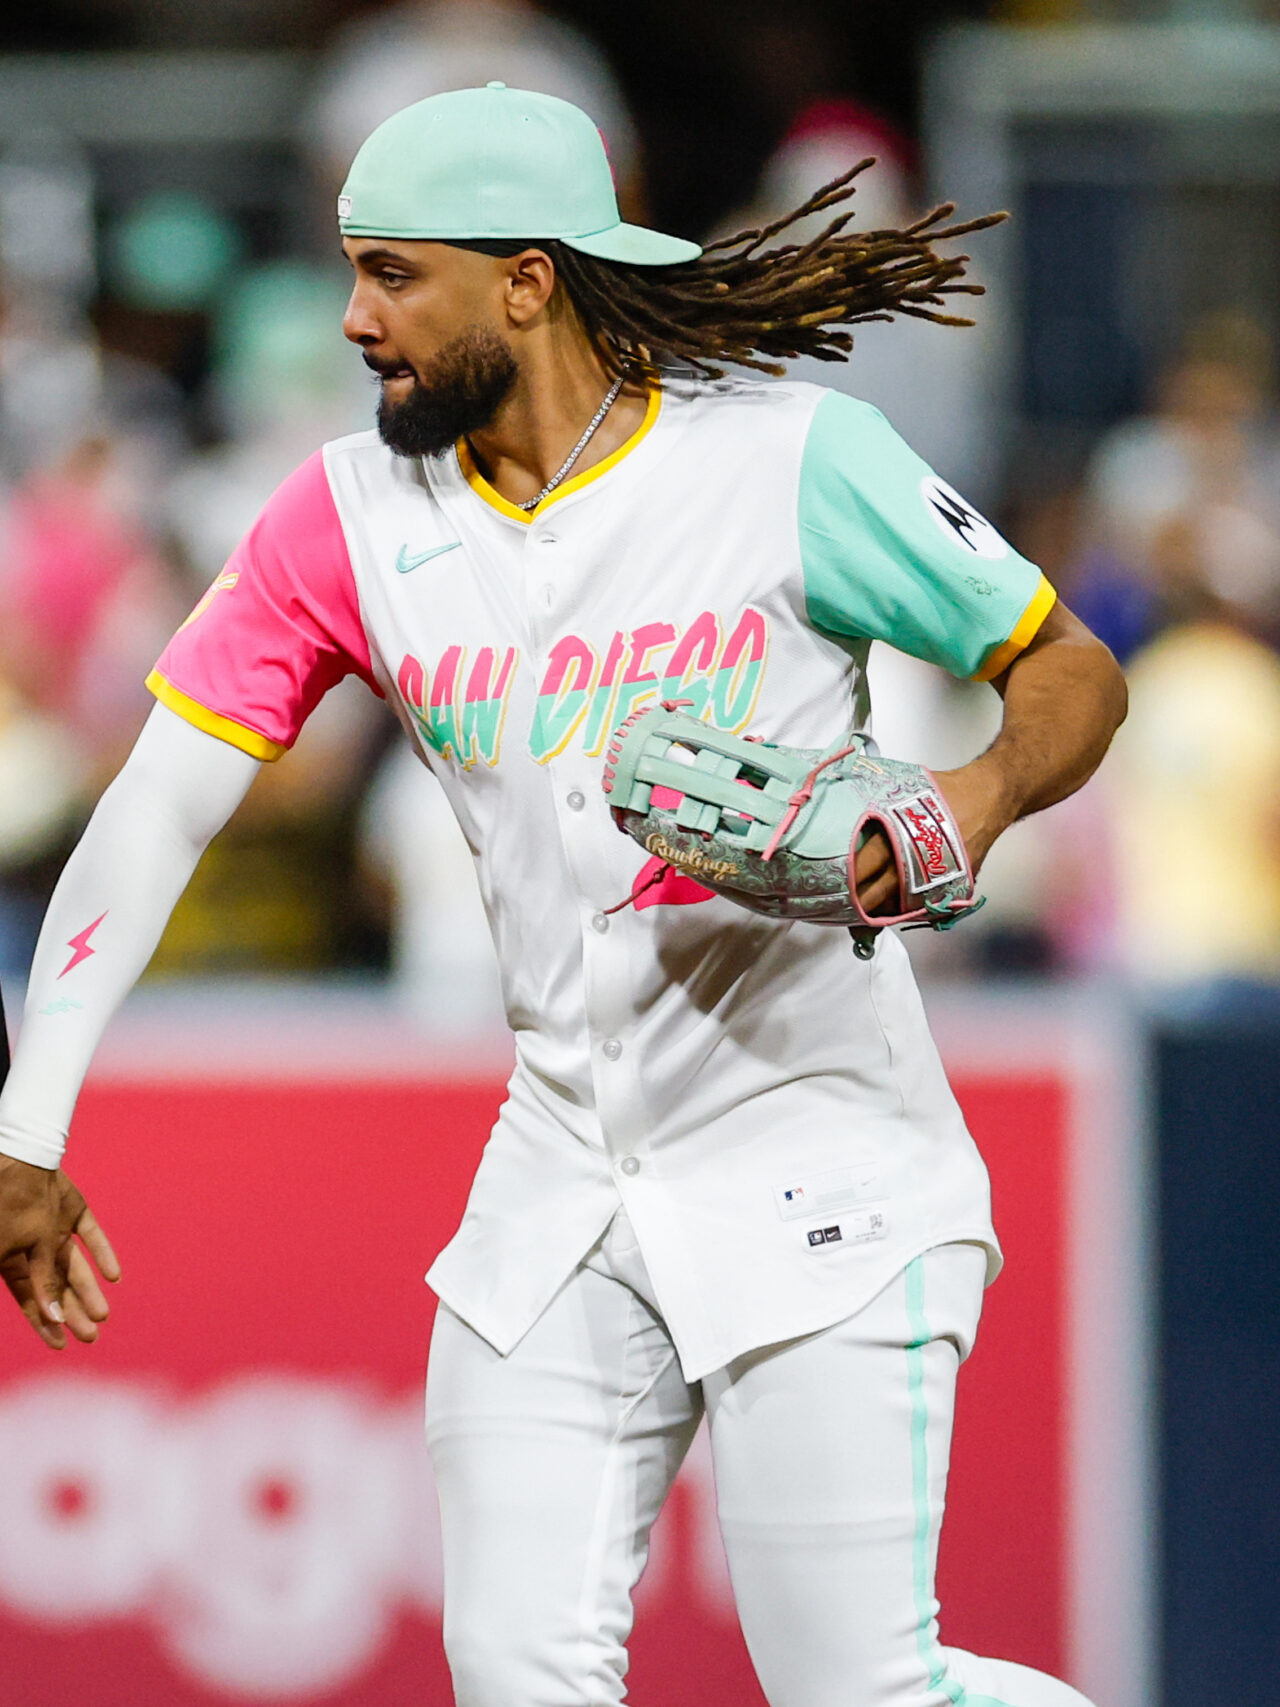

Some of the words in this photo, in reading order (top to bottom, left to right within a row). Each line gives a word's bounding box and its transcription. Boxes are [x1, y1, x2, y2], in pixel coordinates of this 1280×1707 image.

[398, 644, 519, 772] SAN
[528, 604, 770, 766] DIEGO
[645, 832, 740, 881] Rawlings
[904, 807, 947, 875] Rawlings
